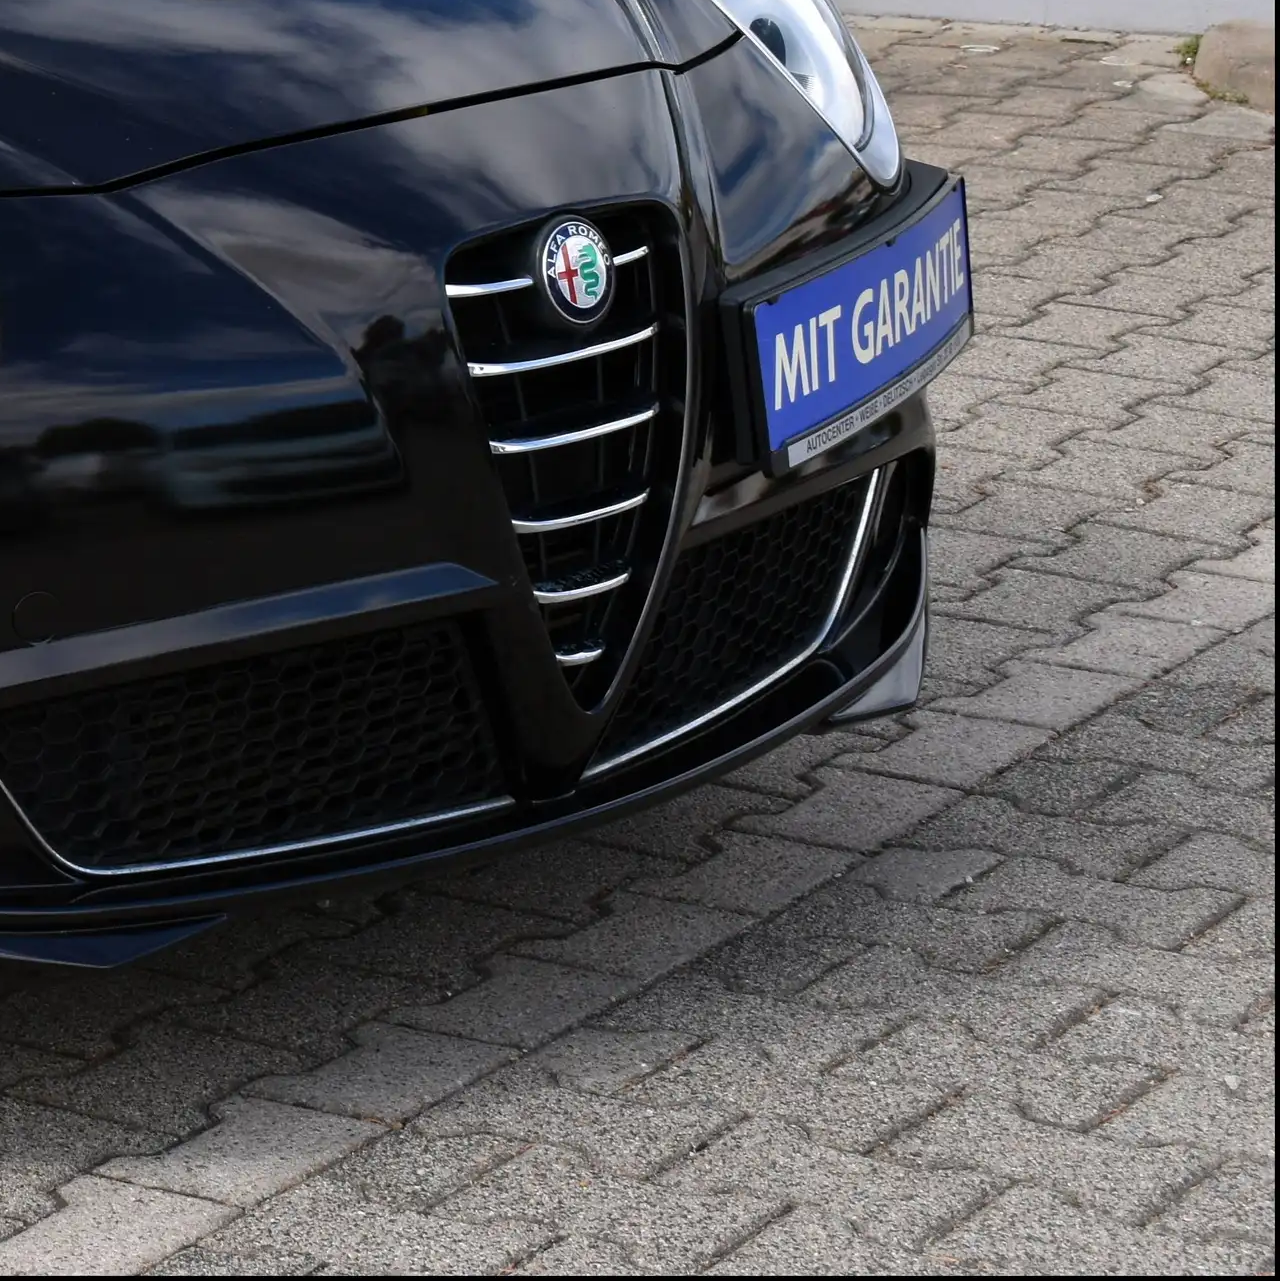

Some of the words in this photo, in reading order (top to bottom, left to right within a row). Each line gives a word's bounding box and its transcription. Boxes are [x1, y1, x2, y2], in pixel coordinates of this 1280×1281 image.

[547, 234, 566, 278] ALFA
[567, 225, 611, 266] ROMEO
[774, 304, 841, 411] MIT
[850, 217, 964, 365] GARANTIE
[806, 416, 855, 454] AUTOCENTER
